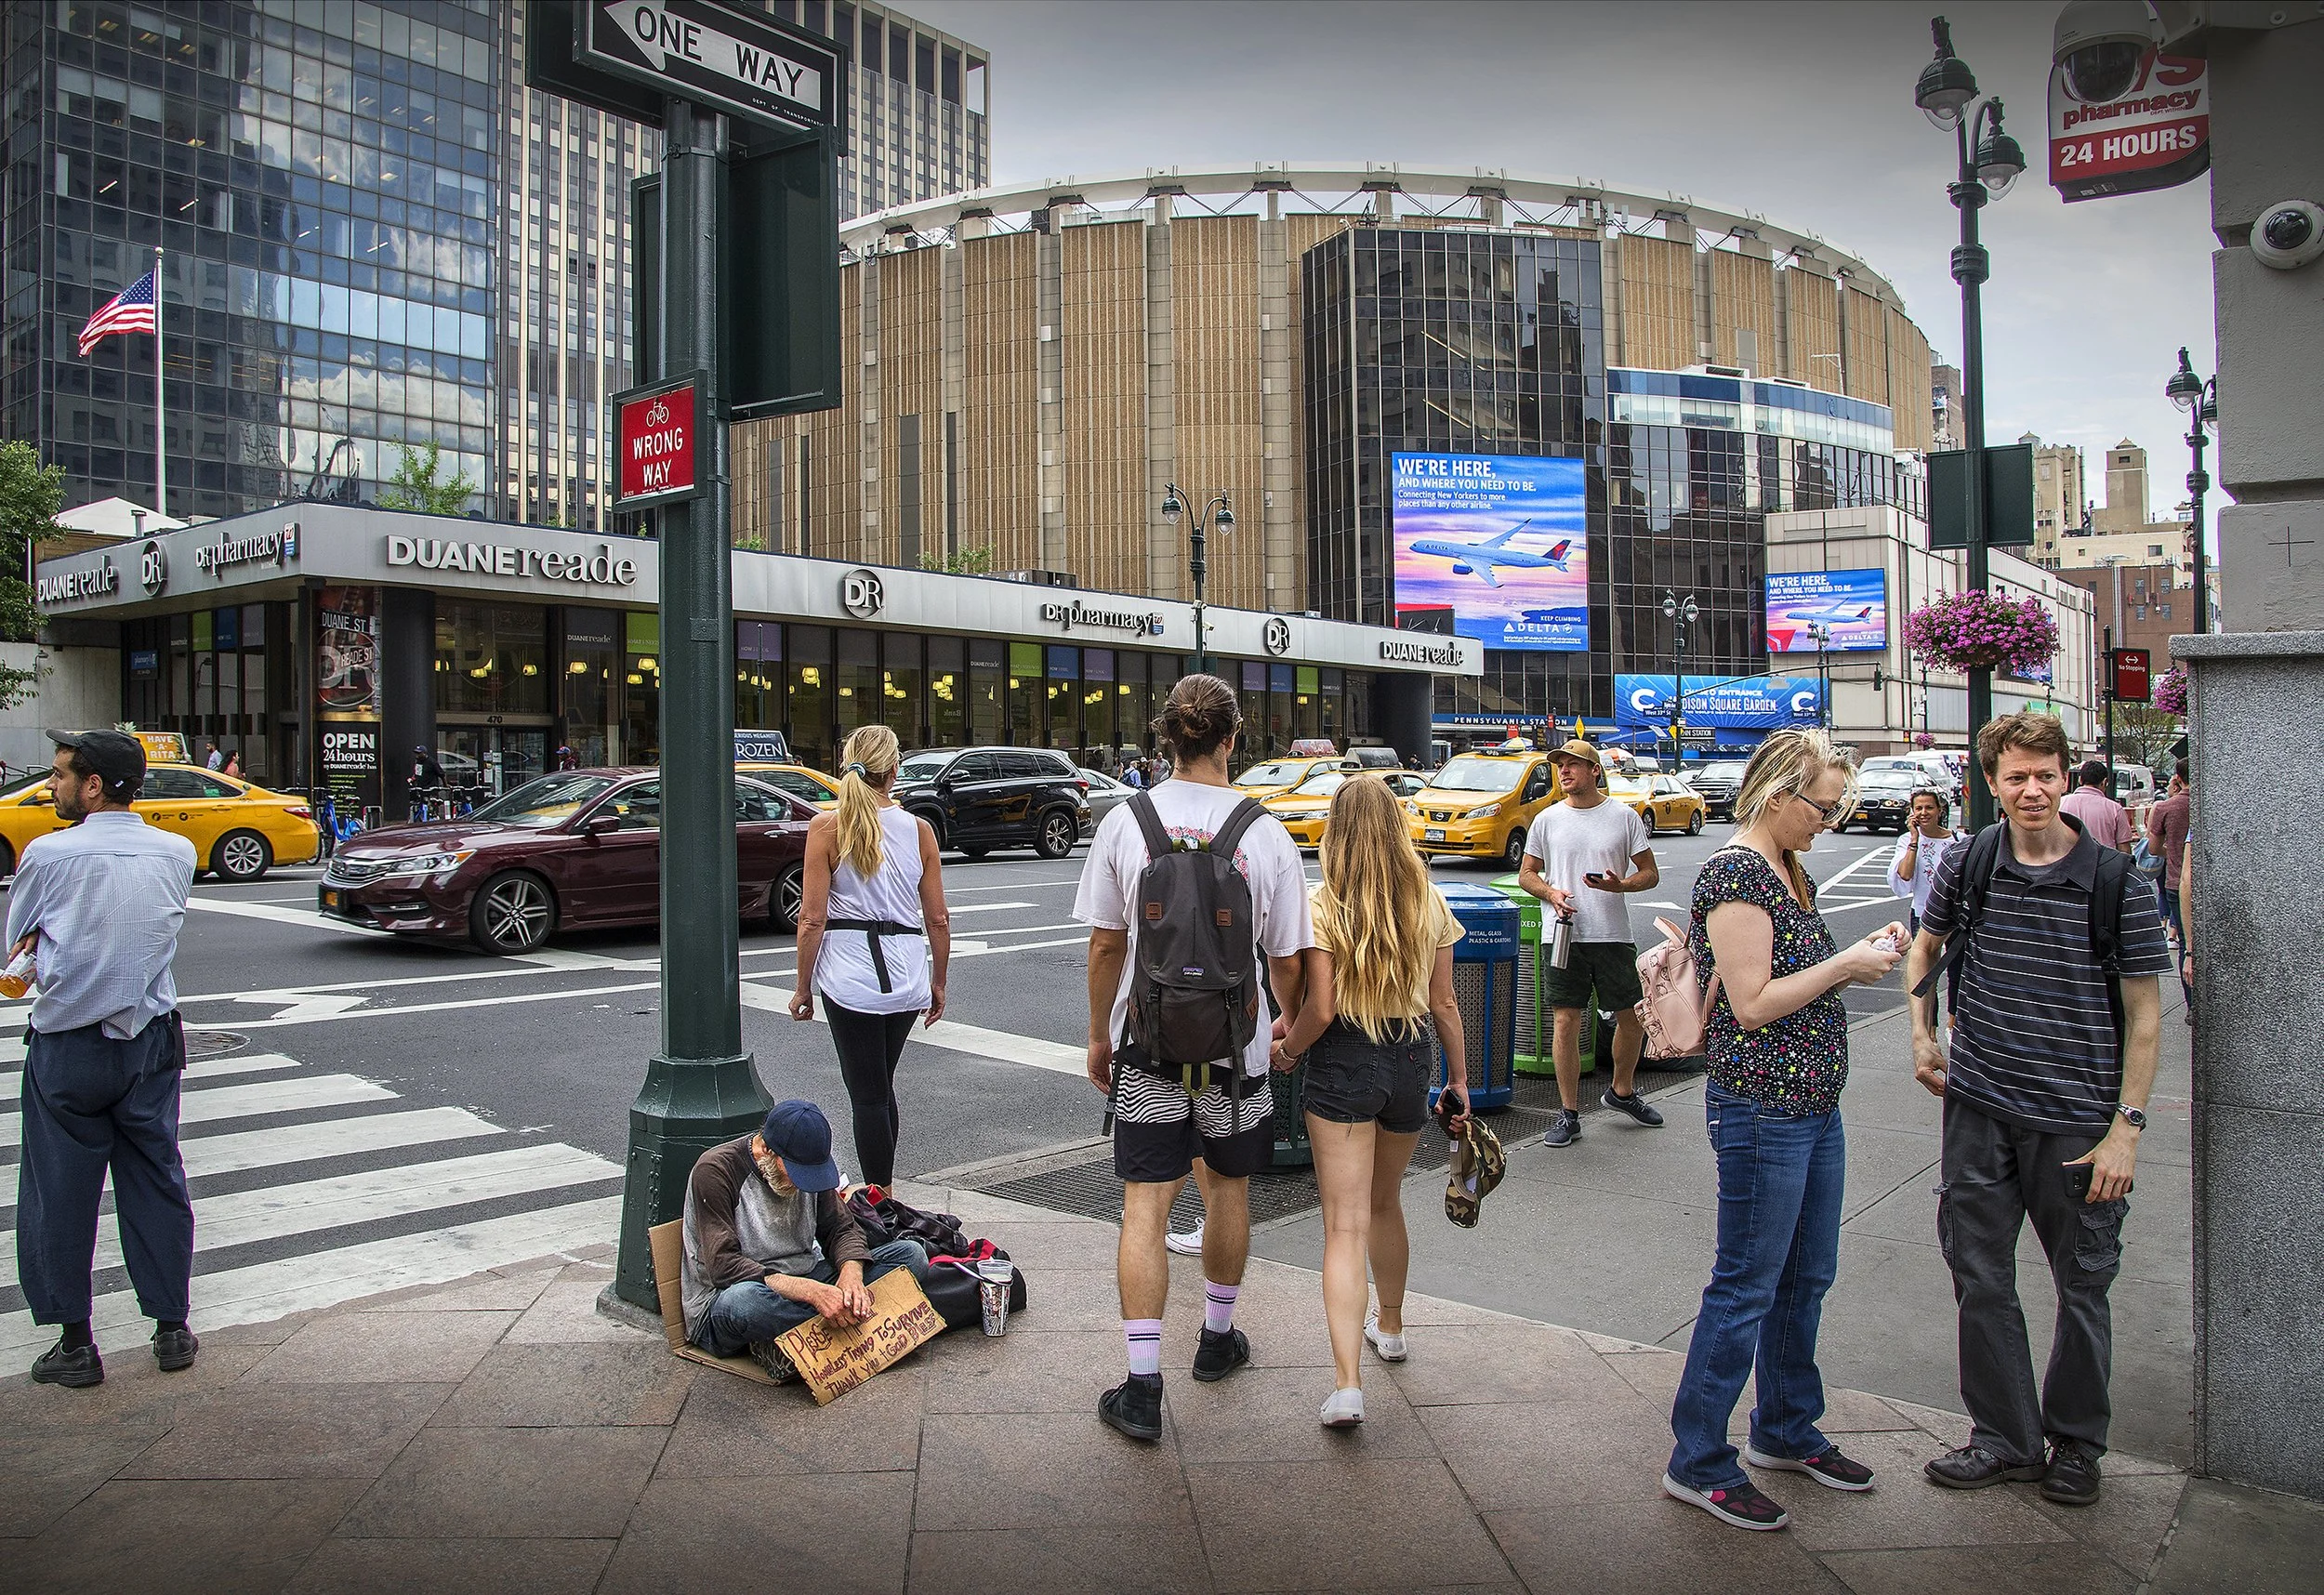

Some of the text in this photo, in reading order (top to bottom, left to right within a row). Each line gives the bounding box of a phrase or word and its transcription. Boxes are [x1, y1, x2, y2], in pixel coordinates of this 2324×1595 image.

[635, 6, 804, 98] ONE WAY
[2063, 88, 2202, 130] pharmacy
[2060, 125, 2197, 167] 24 HOURS
[633, 427, 683, 460] WRONG
[643, 458, 672, 487] WAY
[1397, 458, 1497, 479] WE'RE HERE,
[1398, 478, 1537, 492] AND WHERE YOU NEED TO BE.
[1398, 490, 1506, 502] Connecting New Yorkers to more
[1398, 500, 1493, 510] places than any other airline.
[196, 530, 284, 576] DR pharmacy
[141, 549, 164, 585] DR
[1768, 574, 1830, 587] WE'RE HERE,
[844, 578, 882, 609] DR
[322, 612, 367, 633] DUANE ST
[1045, 600, 1152, 637] DR pharmacy
[1517, 623, 1560, 633] DELTA
[1266, 624, 1290, 649] DR
[341, 646, 374, 667] READE ST
[2125, 665, 2146, 673] Stopping
[1709, 697, 1742, 711] SQUARE
[487, 716, 503, 724] 470
[1454, 717, 1525, 725] PENNSYLVANIA
[147, 735, 174, 744] HAVE
[323, 732, 376, 749] OPEN
[1692, 729, 1711, 737] STATION
[149, 750, 177, 759] RITA
[824, 1367, 863, 1397] THANK
